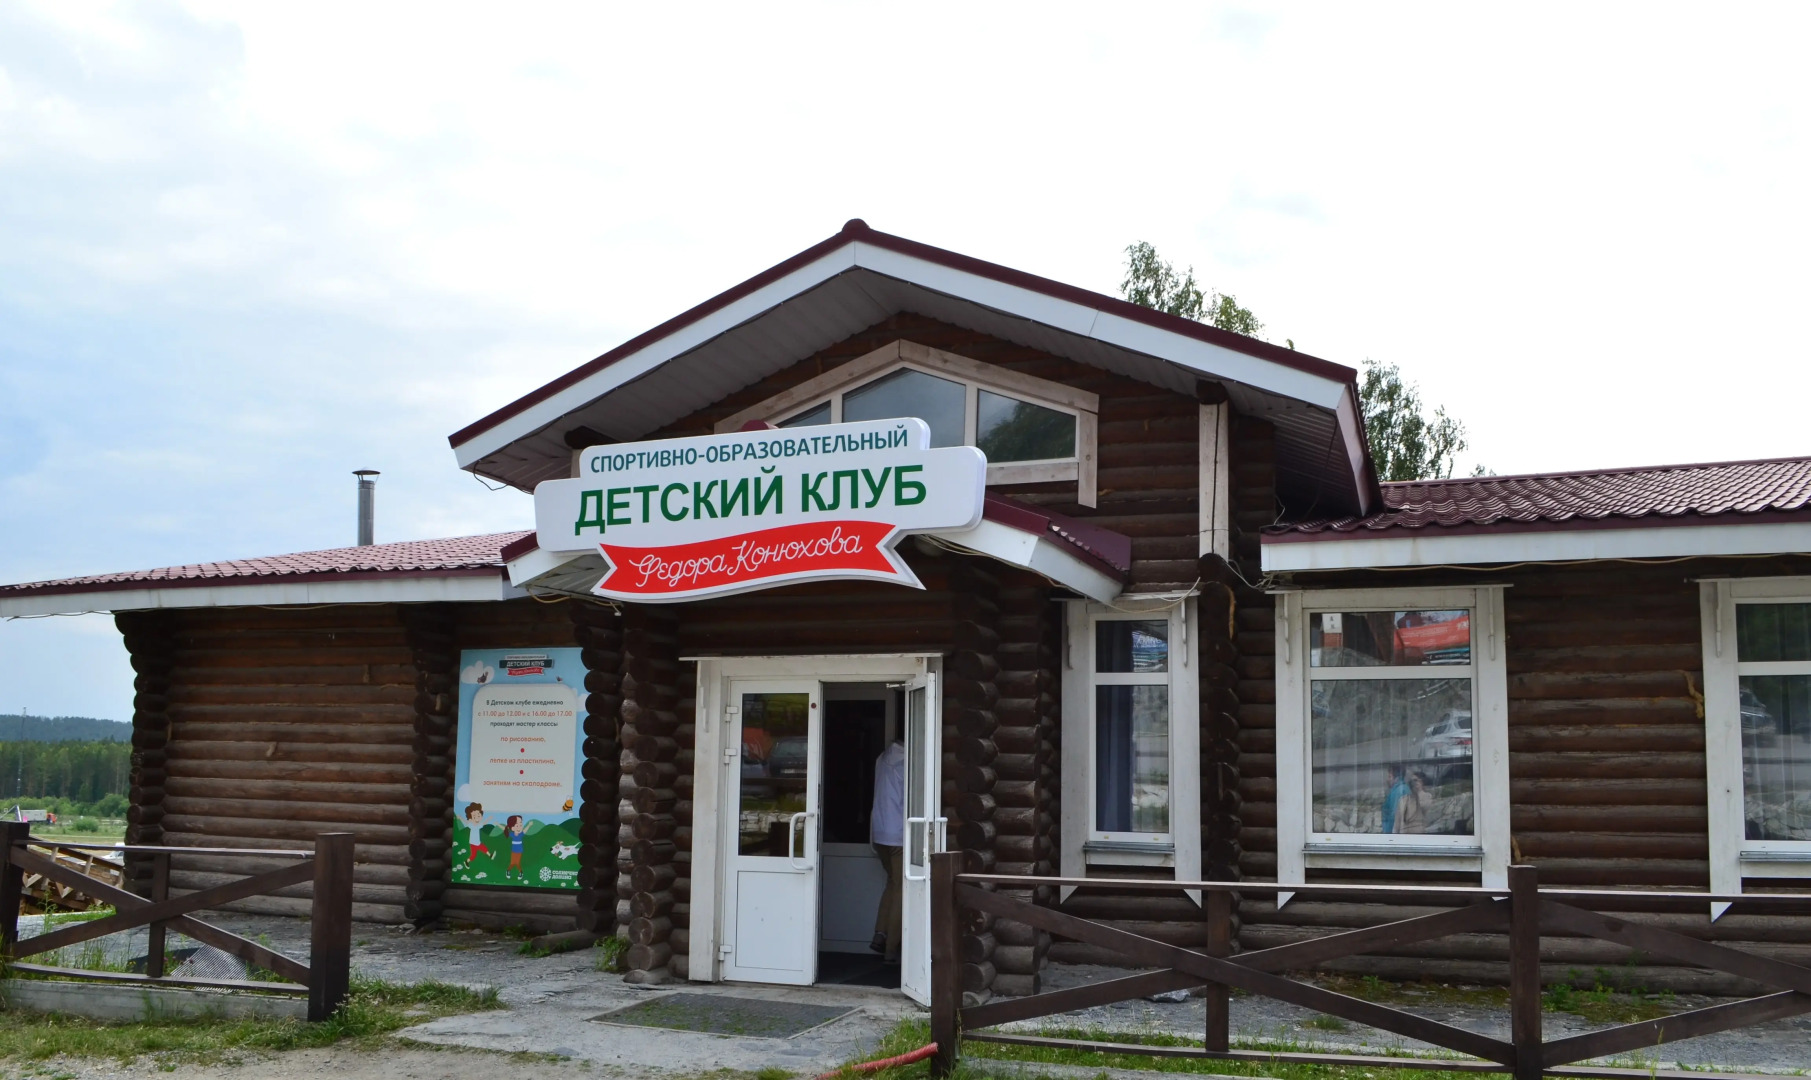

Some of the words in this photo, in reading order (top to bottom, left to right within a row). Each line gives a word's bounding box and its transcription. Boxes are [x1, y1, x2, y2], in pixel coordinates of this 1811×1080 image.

[590, 424, 908, 473] СПОРТИВНО-ОБРАЗОВАТЕЛЬНЫЙ
[574, 466, 784, 536] ДЕТСКИЙ
[801, 464, 928, 513] КЛУБ
[628, 553, 728, 587] Федора
[726, 526, 863, 576] Конюхова
[515, 699, 531, 707] клубе
